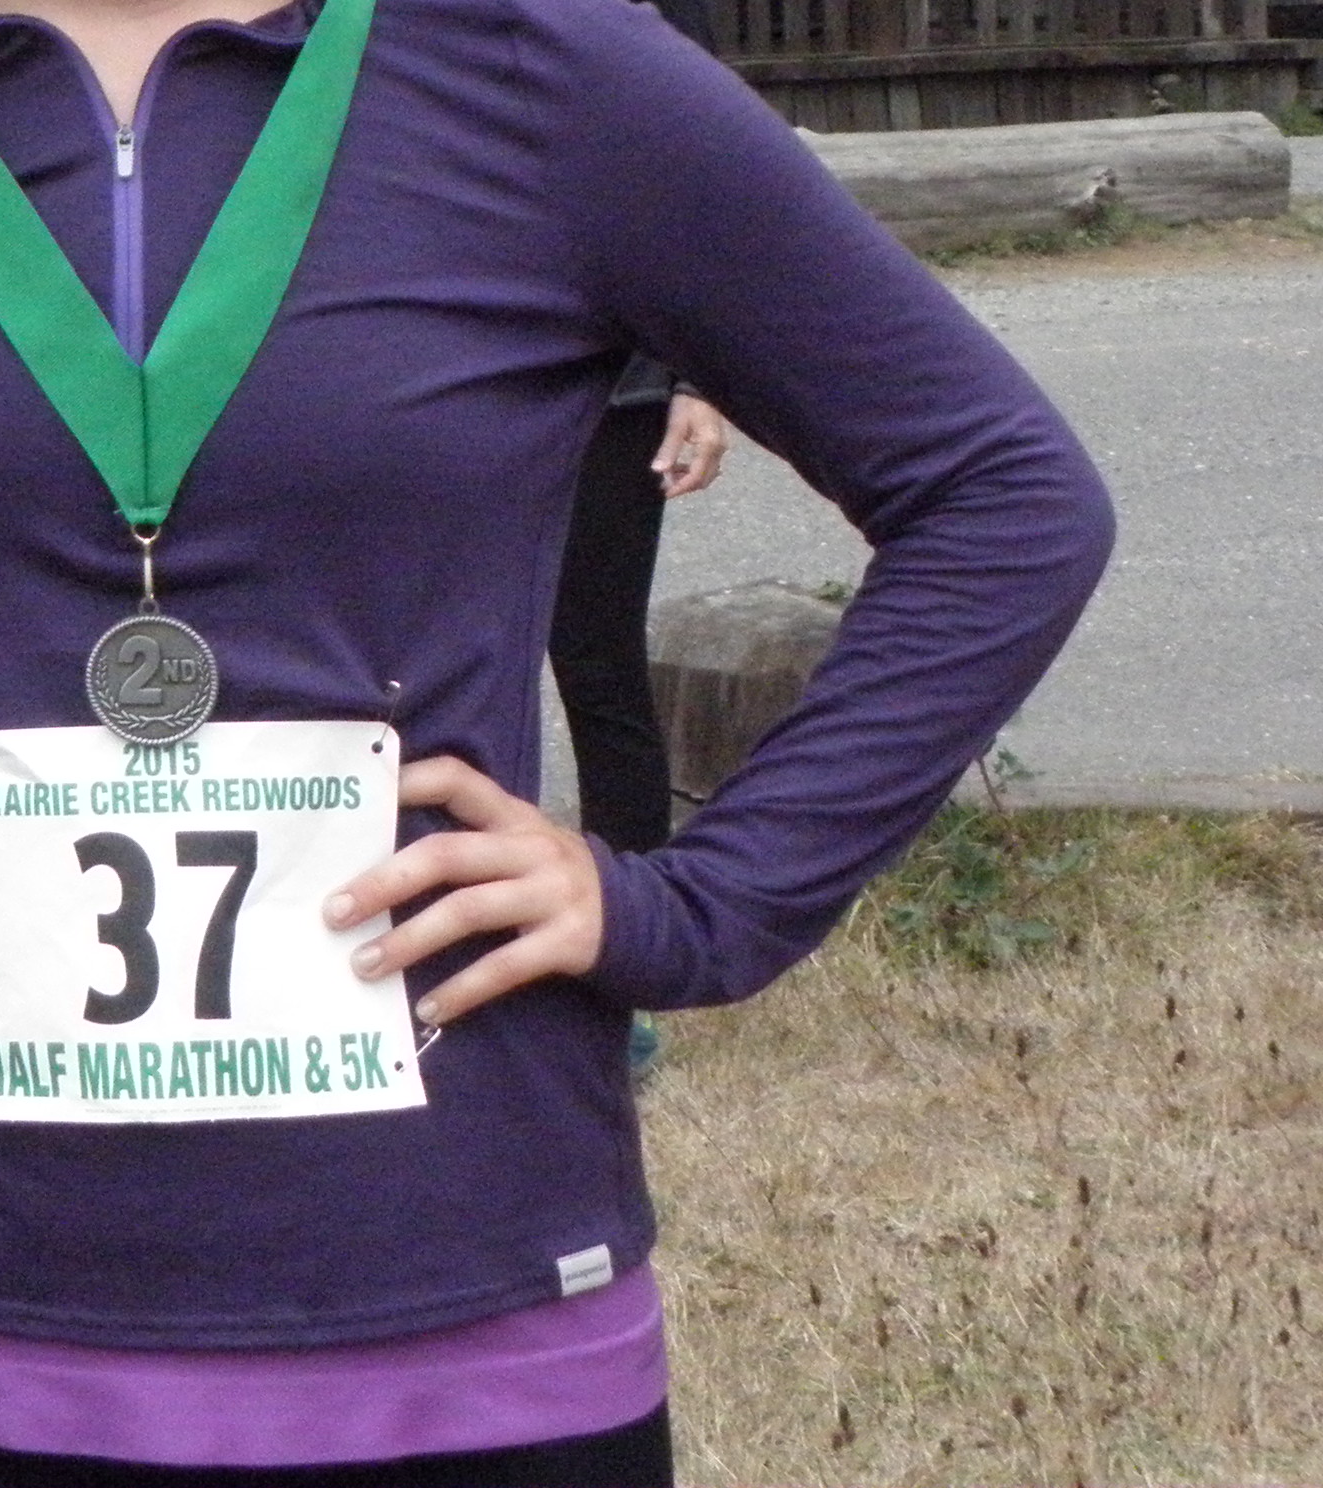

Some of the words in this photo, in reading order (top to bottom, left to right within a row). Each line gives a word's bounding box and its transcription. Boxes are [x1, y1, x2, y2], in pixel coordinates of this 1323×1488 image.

[122, 743, 201, 777] 2015
[90, 779, 194, 814] CREEK
[202, 775, 362, 812] REDWOODS
[72, 829, 259, 1026] 37
[77, 1033, 292, 1101] MARATHON
[304, 1034, 333, 1094] &
[339, 1030, 390, 1091] 5K
